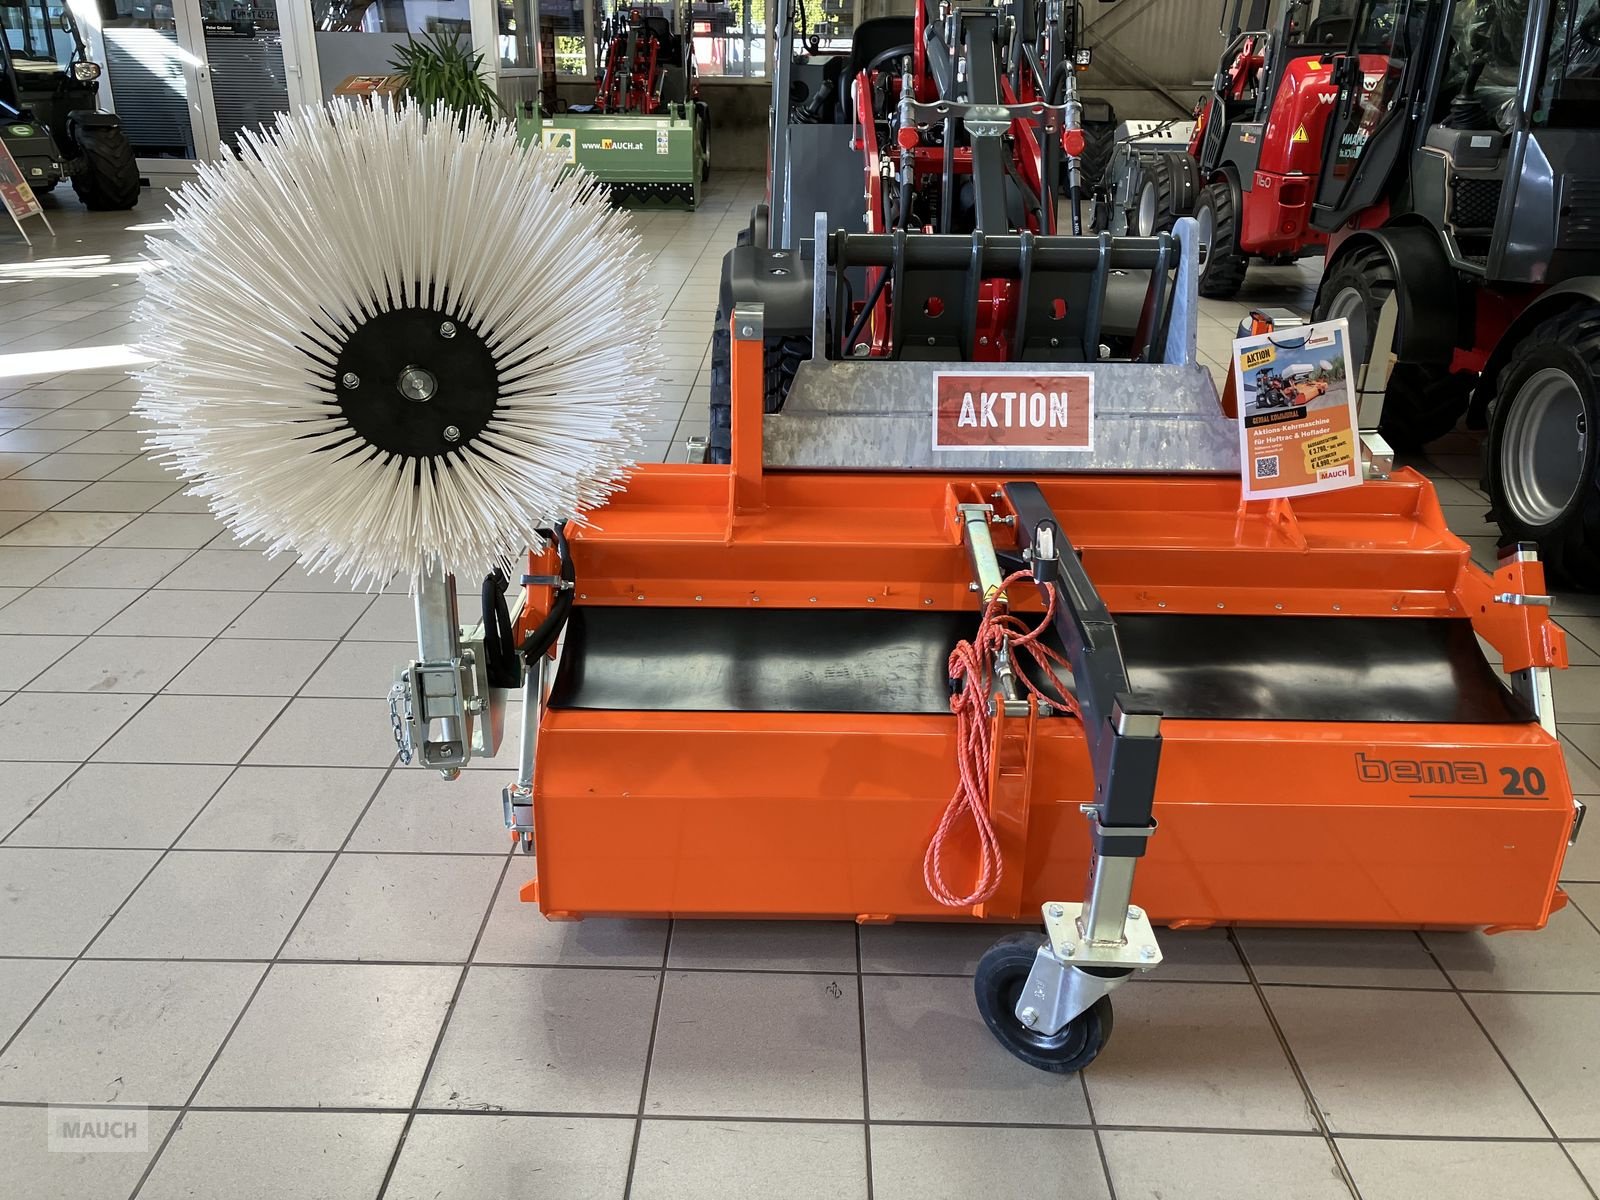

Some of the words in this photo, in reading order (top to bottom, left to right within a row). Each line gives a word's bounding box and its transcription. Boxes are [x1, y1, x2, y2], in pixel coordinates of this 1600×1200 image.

[582, 141, 643, 150] www.MAUCH.at
[1246, 348, 1271, 364] AKTION
[957, 392, 1068, 428] AKTION
[1253, 418, 1330, 436] Aktions-Kehrmaschine
[1254, 438, 1265, 446] für
[1266, 434, 1293, 444] Hoftrac
[1301, 427, 1330, 438] Hoflader
[1321, 469, 1347, 479] MAUCH
[1355, 752, 1488, 785] bema
[1499, 766, 1546, 796] 20
